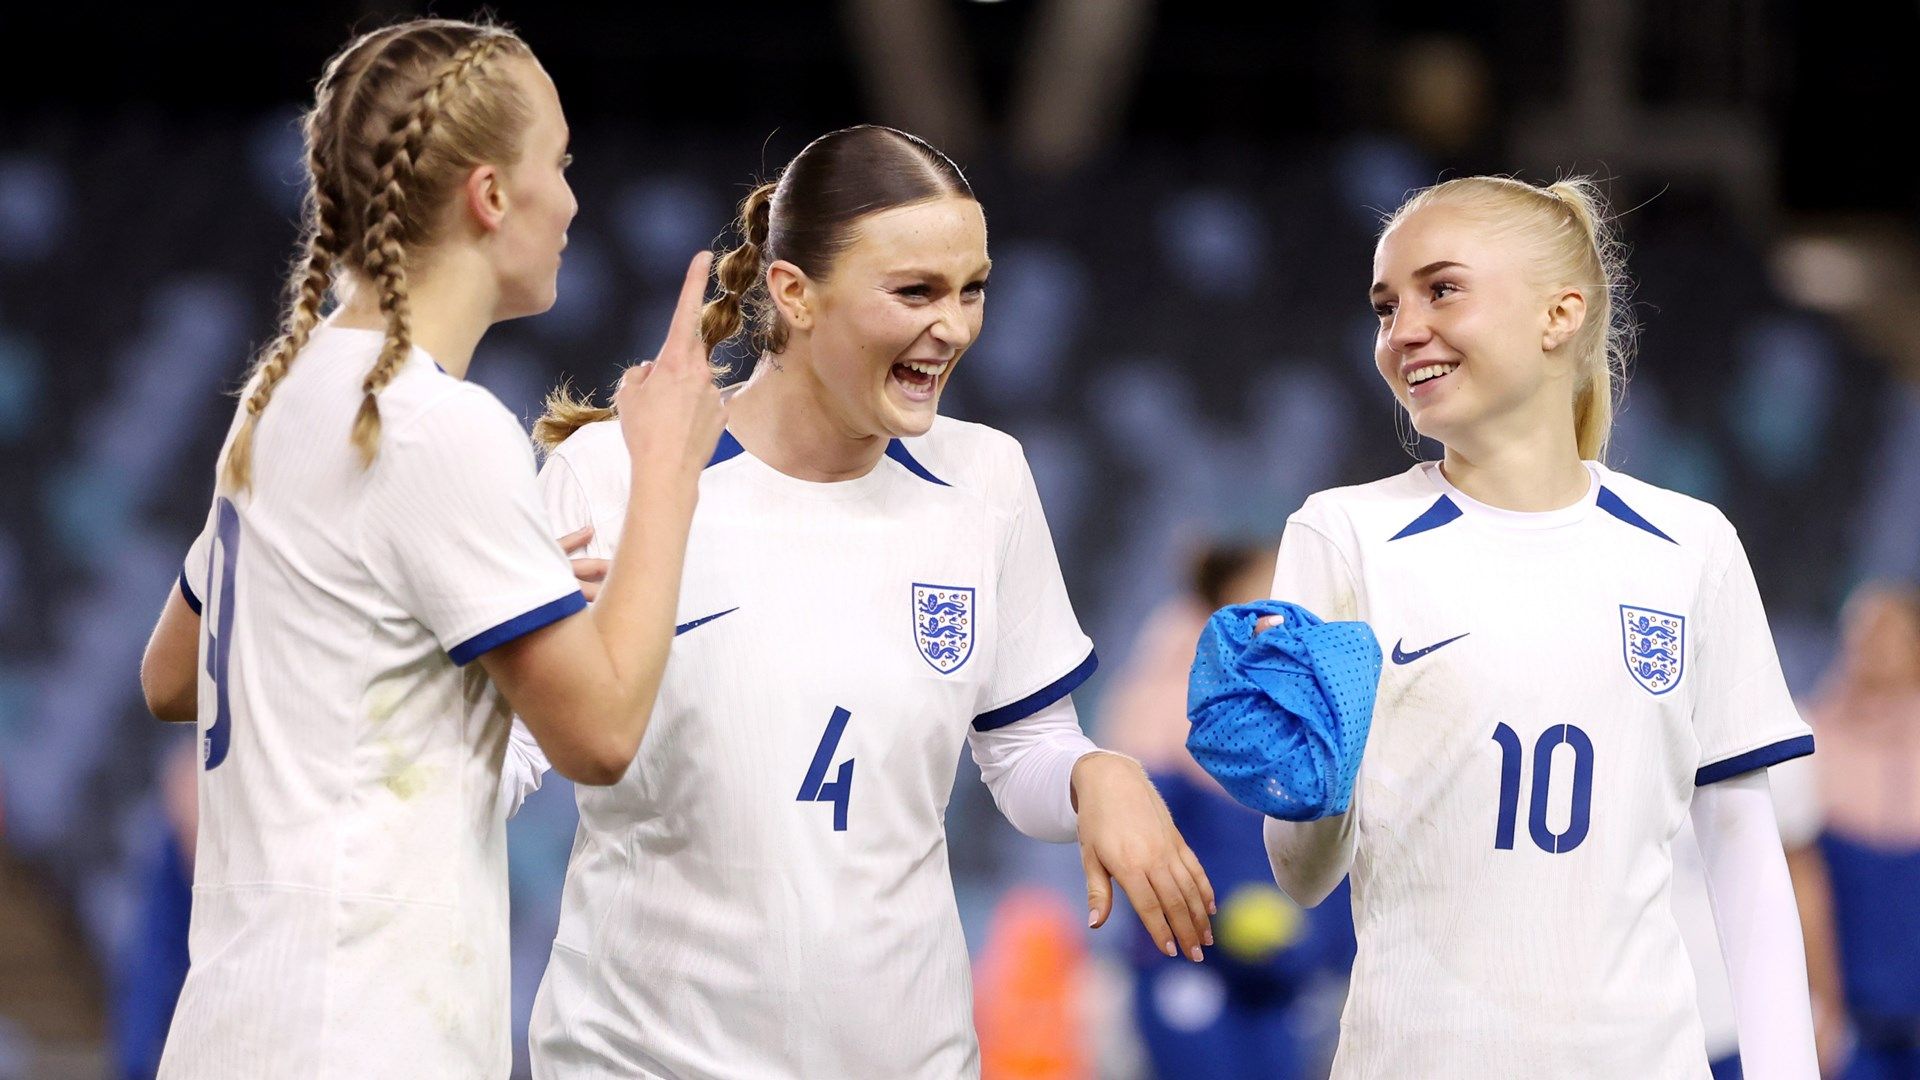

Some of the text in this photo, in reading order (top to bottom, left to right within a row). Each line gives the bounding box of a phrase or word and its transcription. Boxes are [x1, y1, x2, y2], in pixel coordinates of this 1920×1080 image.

[205, 497, 240, 770] 9
[796, 705, 854, 831] 4
[1492, 722, 1594, 854] 10
